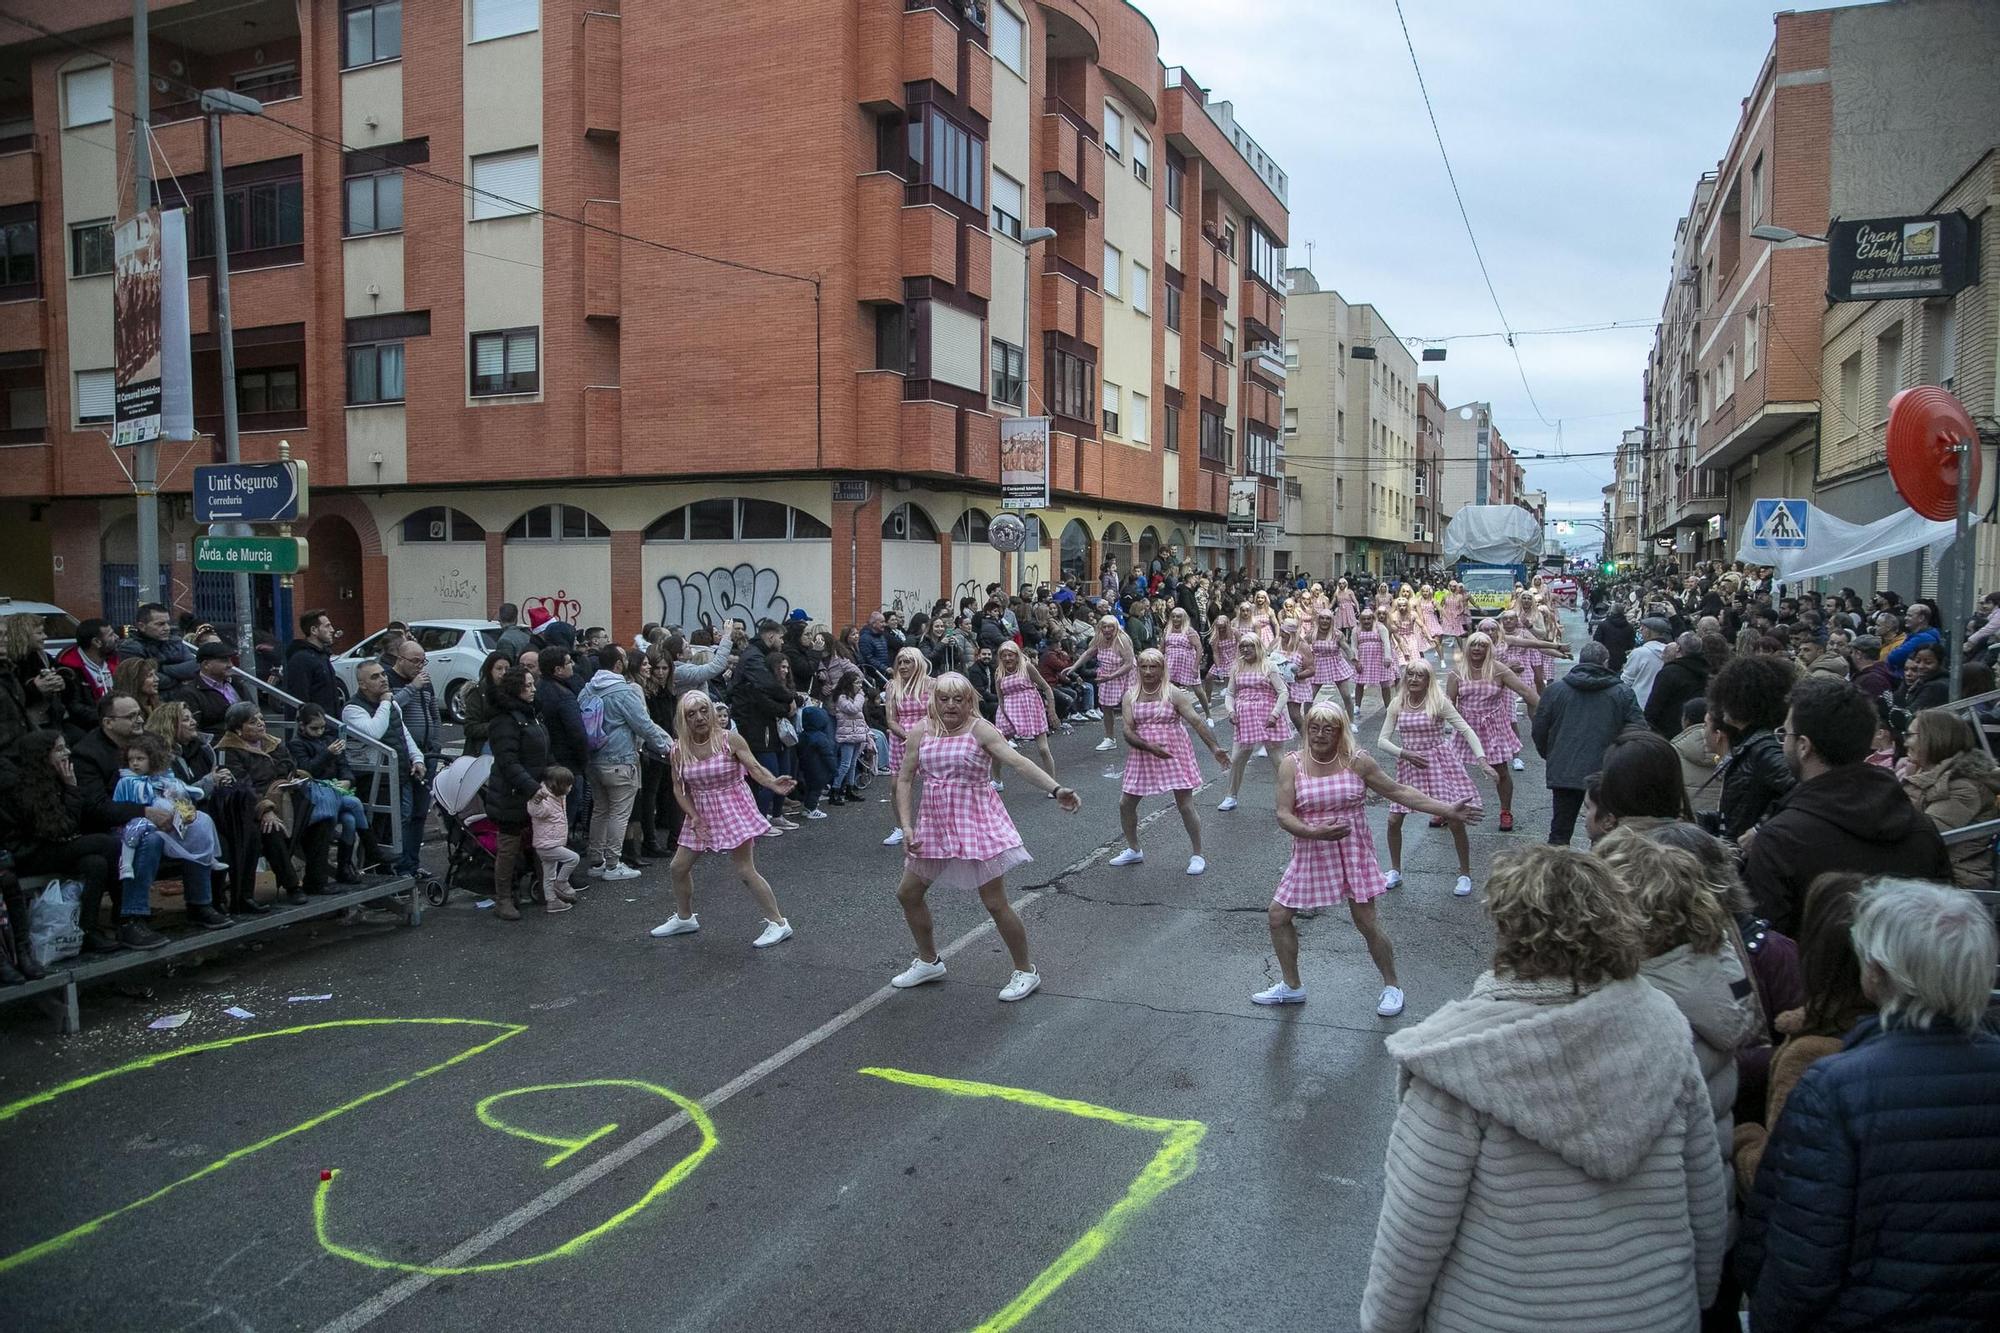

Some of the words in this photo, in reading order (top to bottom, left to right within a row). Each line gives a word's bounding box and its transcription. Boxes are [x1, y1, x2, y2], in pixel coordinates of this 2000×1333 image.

[1856, 224, 1898, 245] Gran
[1856, 242, 1902, 264] Cheff
[1852, 263, 1942, 280] RESTAURANTE
[208, 474, 232, 492] Unit
[234, 474, 279, 494] Seguros
[208, 495, 243, 506] Correduría
[199, 547, 224, 561] Avda.
[226, 549, 238, 561] de
[240, 548, 273, 562] Murcia
